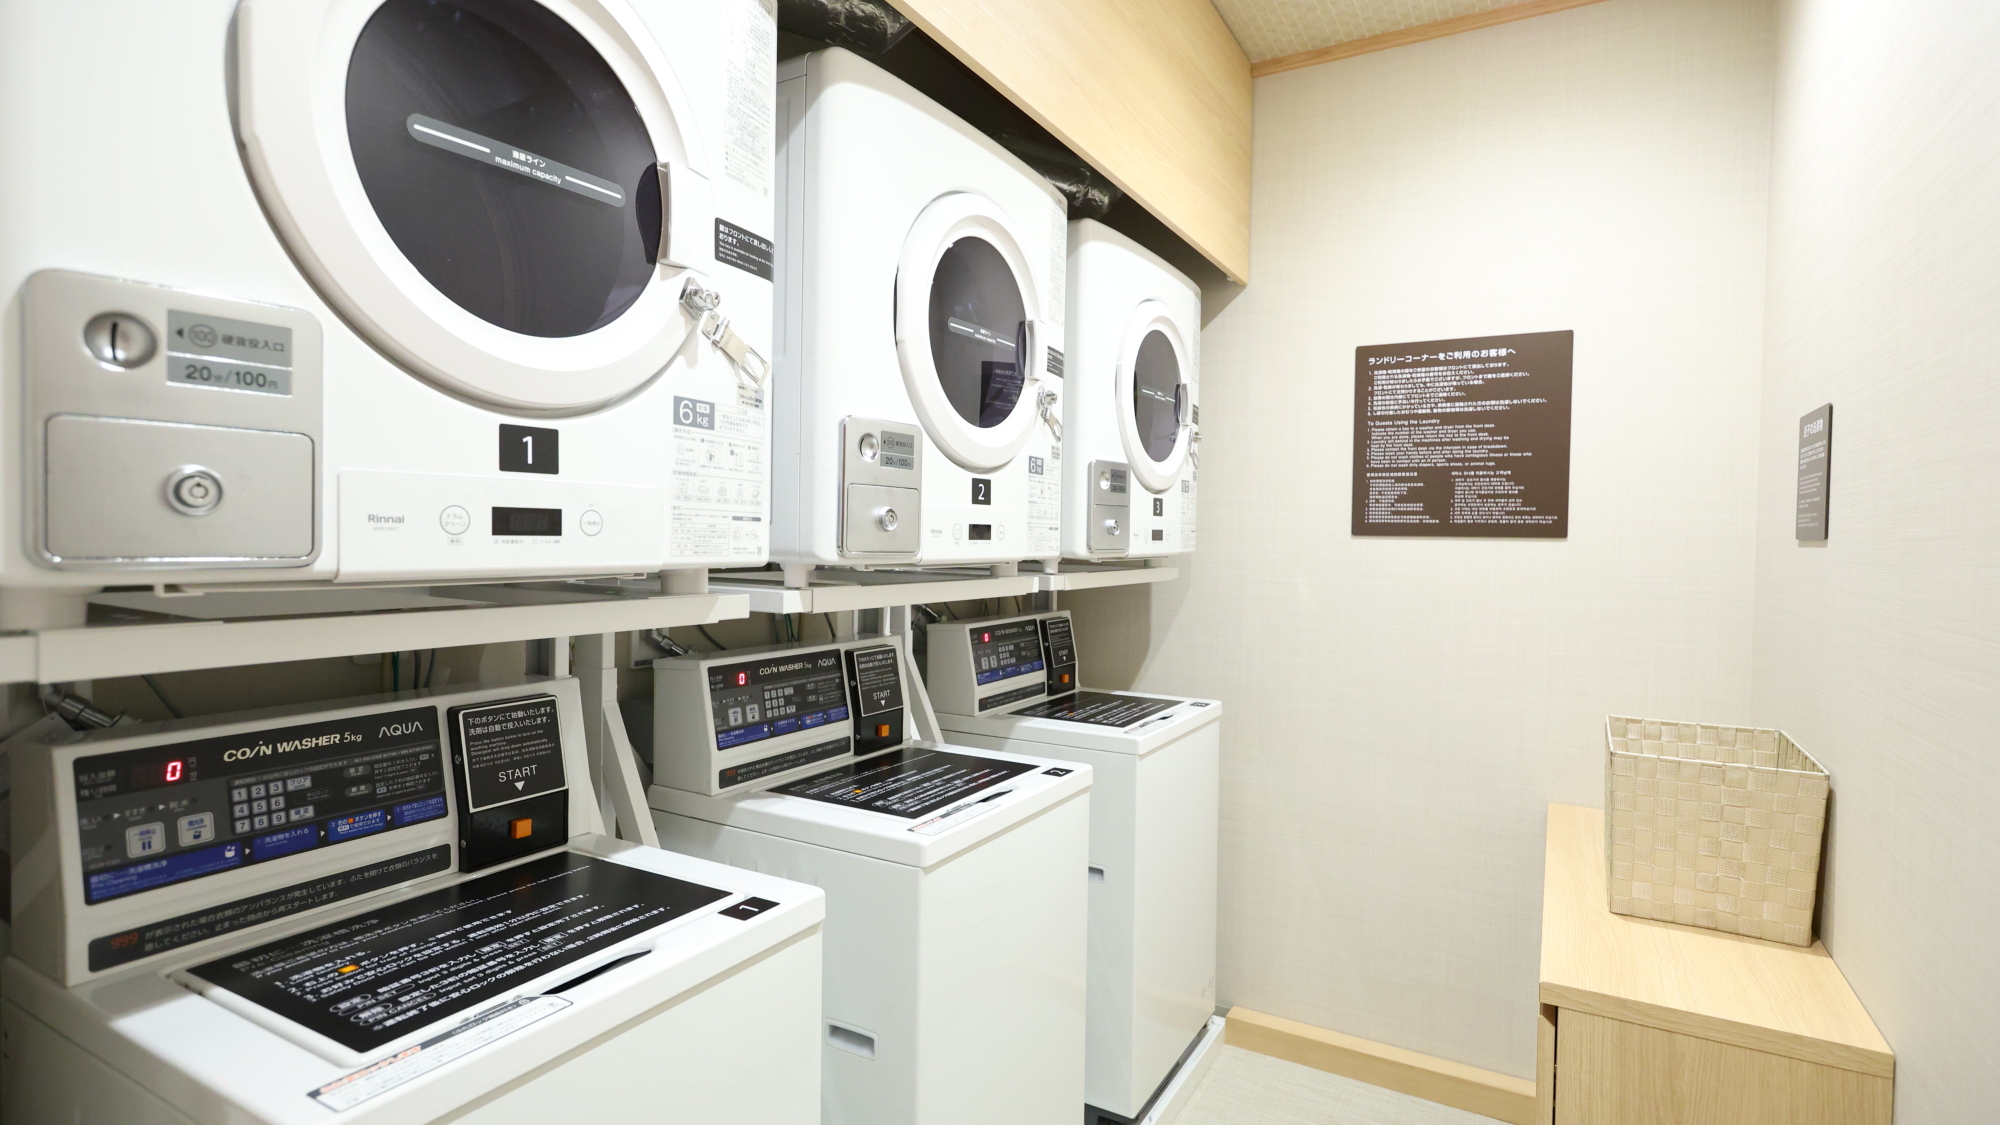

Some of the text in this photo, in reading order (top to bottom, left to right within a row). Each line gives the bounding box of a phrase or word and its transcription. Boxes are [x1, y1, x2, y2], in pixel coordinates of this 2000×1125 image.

[495, 156, 562, 185] maximum capacity
[222, 334, 284, 352] 硬貨投入口
[1368, 348, 1516, 365] ランドリーコーナーをご利用のお客様へ
[678, 400, 694, 426] 6
[696, 413, 709, 428] kg
[521, 435, 534, 465] 1
[1030, 458, 1037, 473] 6
[978, 483, 985, 500] 2
[1156, 502, 1160, 514] 3
[367, 514, 405, 524] Rinnai
[778, 662, 803, 672] WASHER
[818, 658, 836, 666] AQUA
[738, 673, 746, 685] 0
[873, 690, 890, 700] START
[467, 706, 554, 725] 下のボタンにて始動いたします。
[379, 722, 423, 738] AQUA
[469, 716, 550, 736] 洗剤は自動で投入いたします。
[277, 734, 340, 753] WASHER
[343, 732, 362, 742] 5kg
[166, 762, 182, 781] 0
[498, 764, 537, 782] START
[291, 777, 308, 785] クリア
[355, 812, 381, 822] ボタンを押す
[265, 828, 309, 843] 洗濯物を入れる
[110, 932, 138, 949] 999
